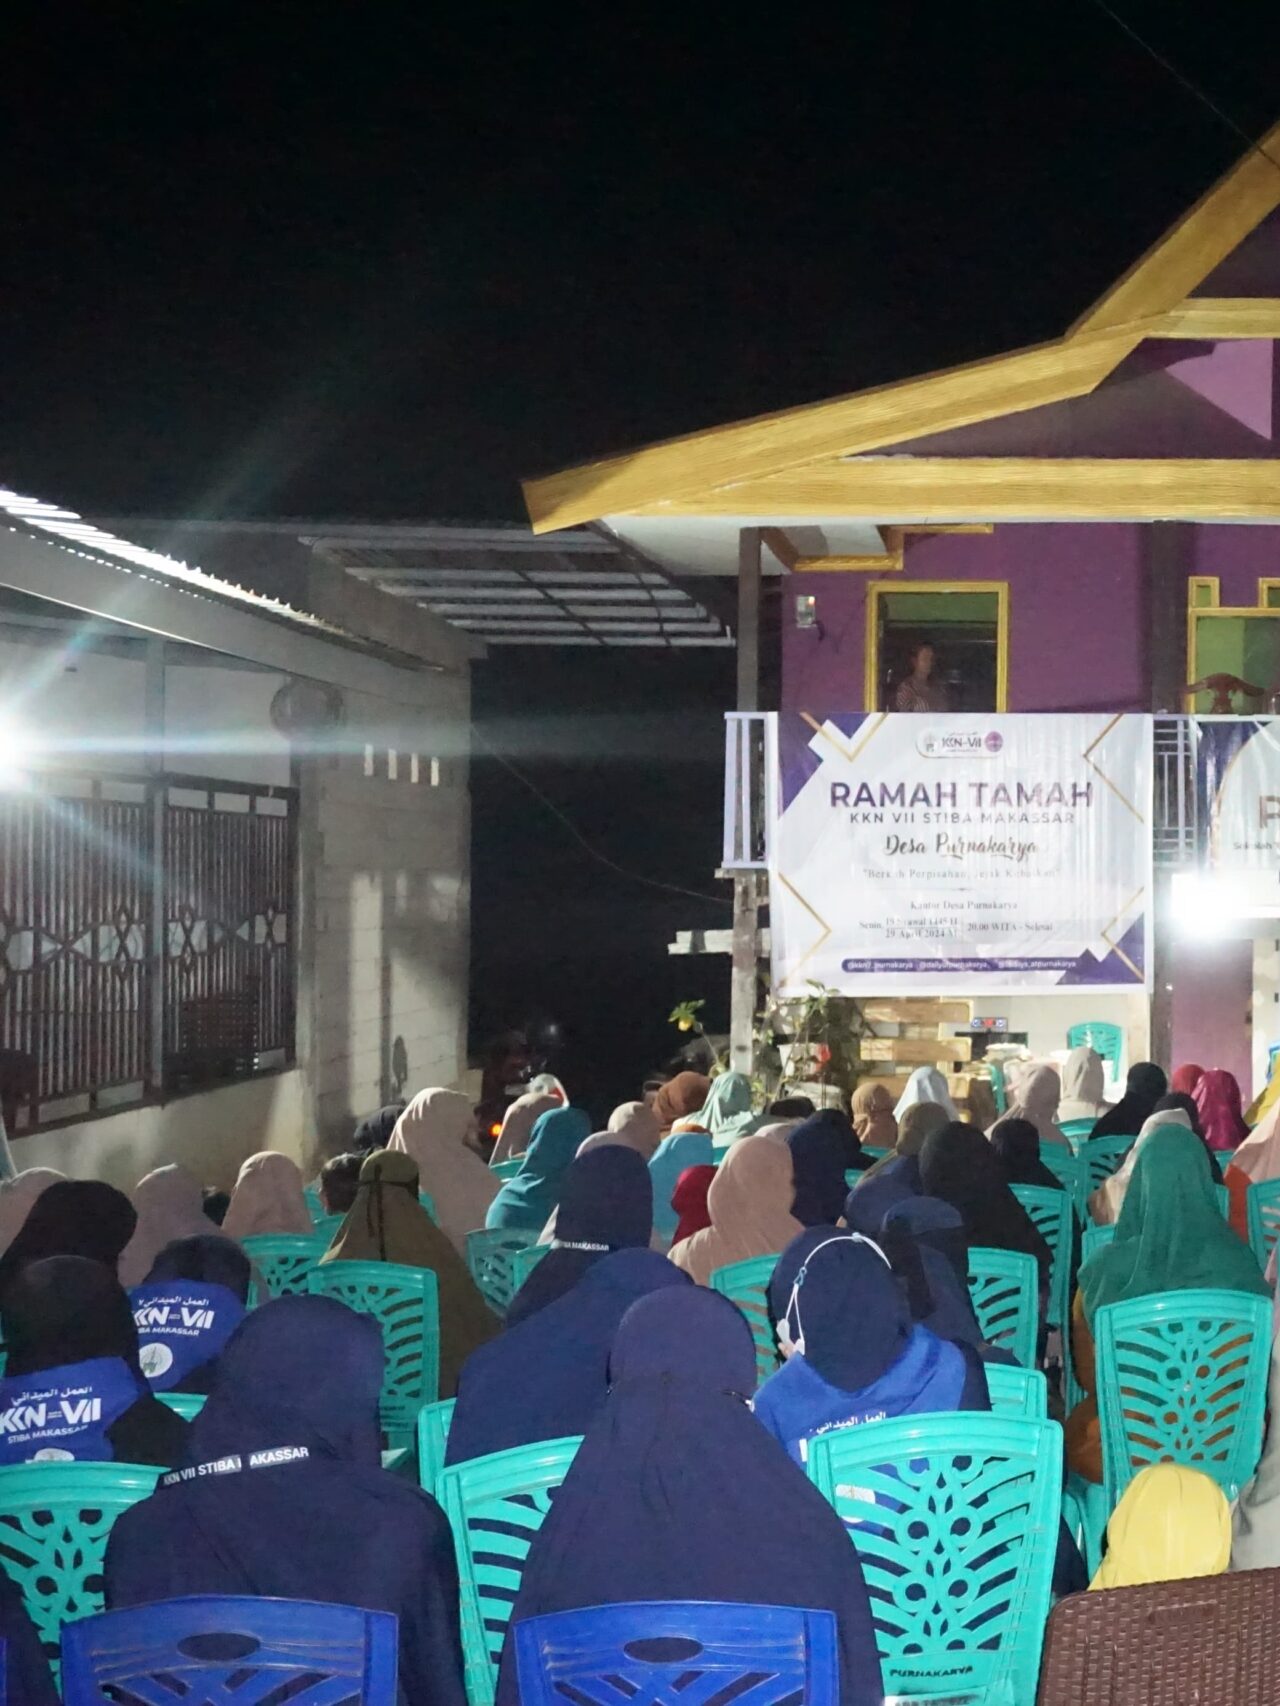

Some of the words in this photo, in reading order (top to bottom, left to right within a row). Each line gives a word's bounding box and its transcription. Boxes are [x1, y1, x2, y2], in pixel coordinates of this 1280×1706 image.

[830, 782, 957, 808] RAMAH
[968, 782, 1093, 808] TAMAH
[850, 813, 884, 824] KKN
[892, 813, 915, 824] VII
[923, 813, 972, 824] STIBA
[981, 813, 1075, 824] MAKASSAR
[885, 834, 926, 856] Desa
[936, 832, 1038, 862] Purnakarya
[152, 1327, 199, 1336] MAKASSAR
[60, 1386, 93, 1398] العمل
[180, 1467, 196, 1480] VII
[198, 1459, 235, 1475] STIBA
[890, 1665, 973, 1677] PURNAKARYA
